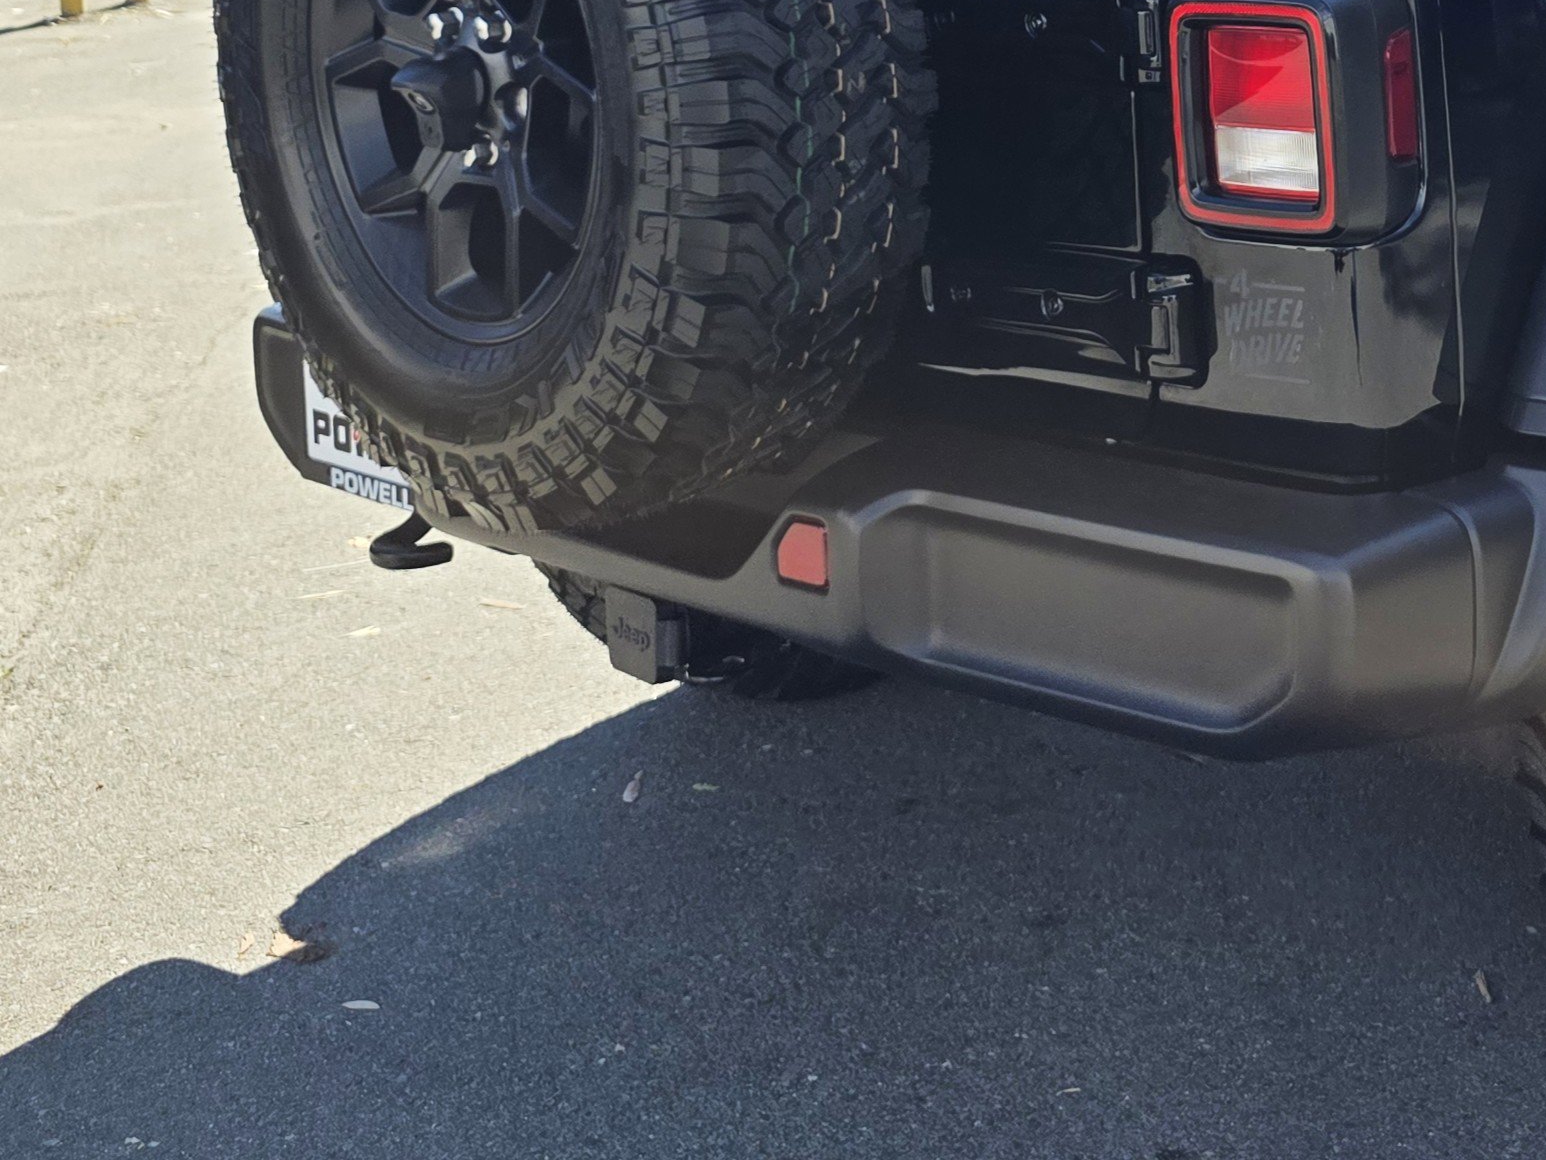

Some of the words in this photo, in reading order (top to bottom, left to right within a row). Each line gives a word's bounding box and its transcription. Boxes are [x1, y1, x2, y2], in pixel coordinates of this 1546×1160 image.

[1230, 267, 1249, 299] 4
[1224, 297, 1304, 336] WHEEL
[1229, 332, 1305, 364] DRIVE
[330, 466, 414, 510] POWELL
[612, 616, 650, 653] Jeep
